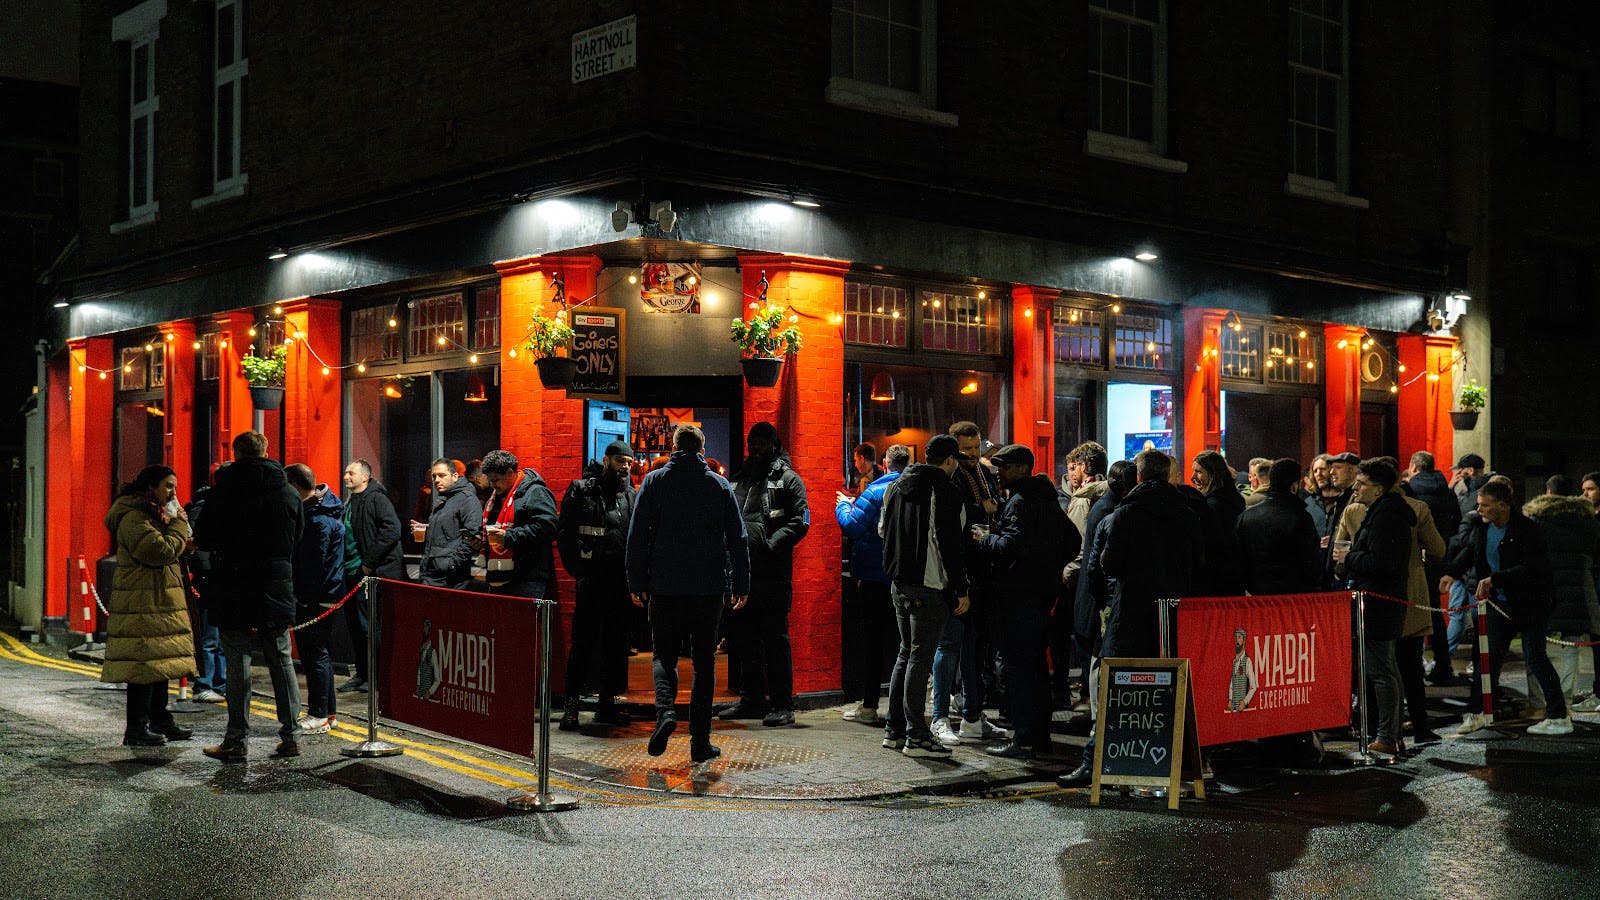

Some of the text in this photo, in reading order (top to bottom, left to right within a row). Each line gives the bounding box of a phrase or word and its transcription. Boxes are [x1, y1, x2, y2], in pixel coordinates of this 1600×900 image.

[575, 29, 633, 61] HARTNOLL
[575, 53, 615, 80] STREET
[660, 296, 685, 306] George
[576, 352, 617, 375] ONLY
[438, 629, 496, 693] MADRÍ
[1253, 623, 1316, 688] MADRÍ
[1117, 673, 1130, 682] sky
[1131, 673, 1155, 682] sports
[442, 686, 490, 716] EXCEPCIONAL
[1108, 688, 1166, 708] HOME
[1259, 687, 1311, 710] EXCEPCIONAL
[1118, 711, 1165, 730] FANS
[1107, 739, 1150, 759] ONLY
